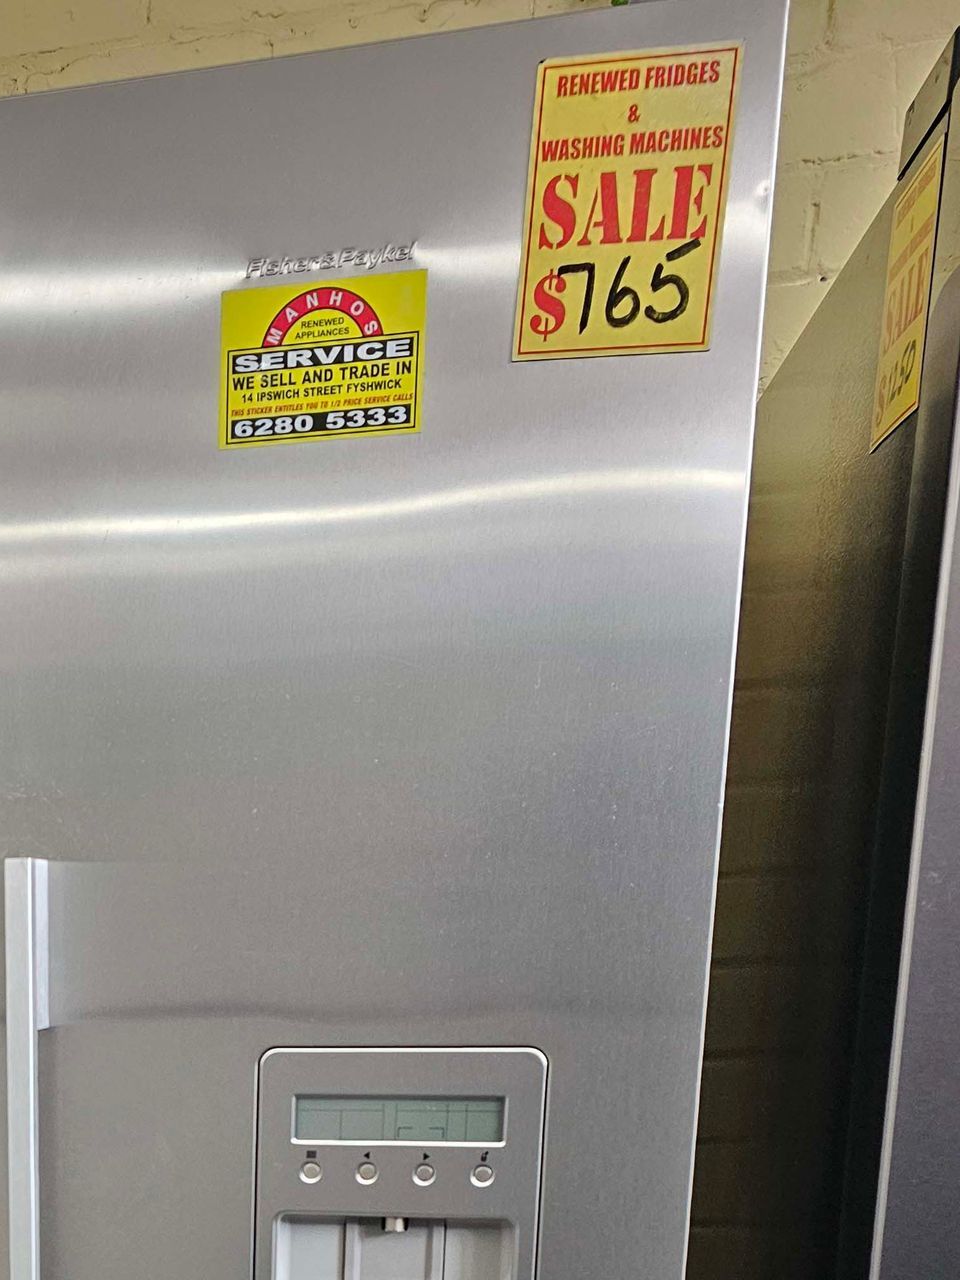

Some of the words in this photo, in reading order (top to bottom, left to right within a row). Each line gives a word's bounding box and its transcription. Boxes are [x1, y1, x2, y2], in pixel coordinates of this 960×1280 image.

[557, 68, 640, 98] RENEWED
[644, 60, 721, 90] FRIDGES
[627, 103, 641, 123] &
[541, 134, 625, 162] WASHING
[628, 125, 724, 155] MACHINES
[538, 163, 714, 250] SALE
[883, 245, 930, 354] SALE
[266, 290, 379, 345] MANHOS
[295, 326, 350, 340] APPLIANCES
[301, 317, 345, 329] RENEWED
[234, 338, 411, 373] SERVICE
[232, 376, 255, 391] WE
[260, 372, 297, 388] SELL
[301, 367, 333, 385] AND
[339, 363, 390, 380] TRADE
[396, 360, 411, 375] IN
[242, 393, 253, 403] 14
[256, 389, 300, 402] IPSWICH
[303, 384, 343, 397] STREET
[346, 378, 402, 393] FYSHWICK
[231, 408, 244, 417] THIS
[246, 406, 273, 416] STICKER
[274, 403, 304, 413] ENTITLES
[306, 401, 318, 410] YOU
[320, 400, 328, 409] TO
[331, 399, 341, 408] 1/2
[343, 398, 362, 407] PRICE
[364, 395, 391, 405] SERVICE
[393, 392, 413, 401] CALLS
[234, 414, 314, 437] 6280
[325, 406, 407, 429] 5333
